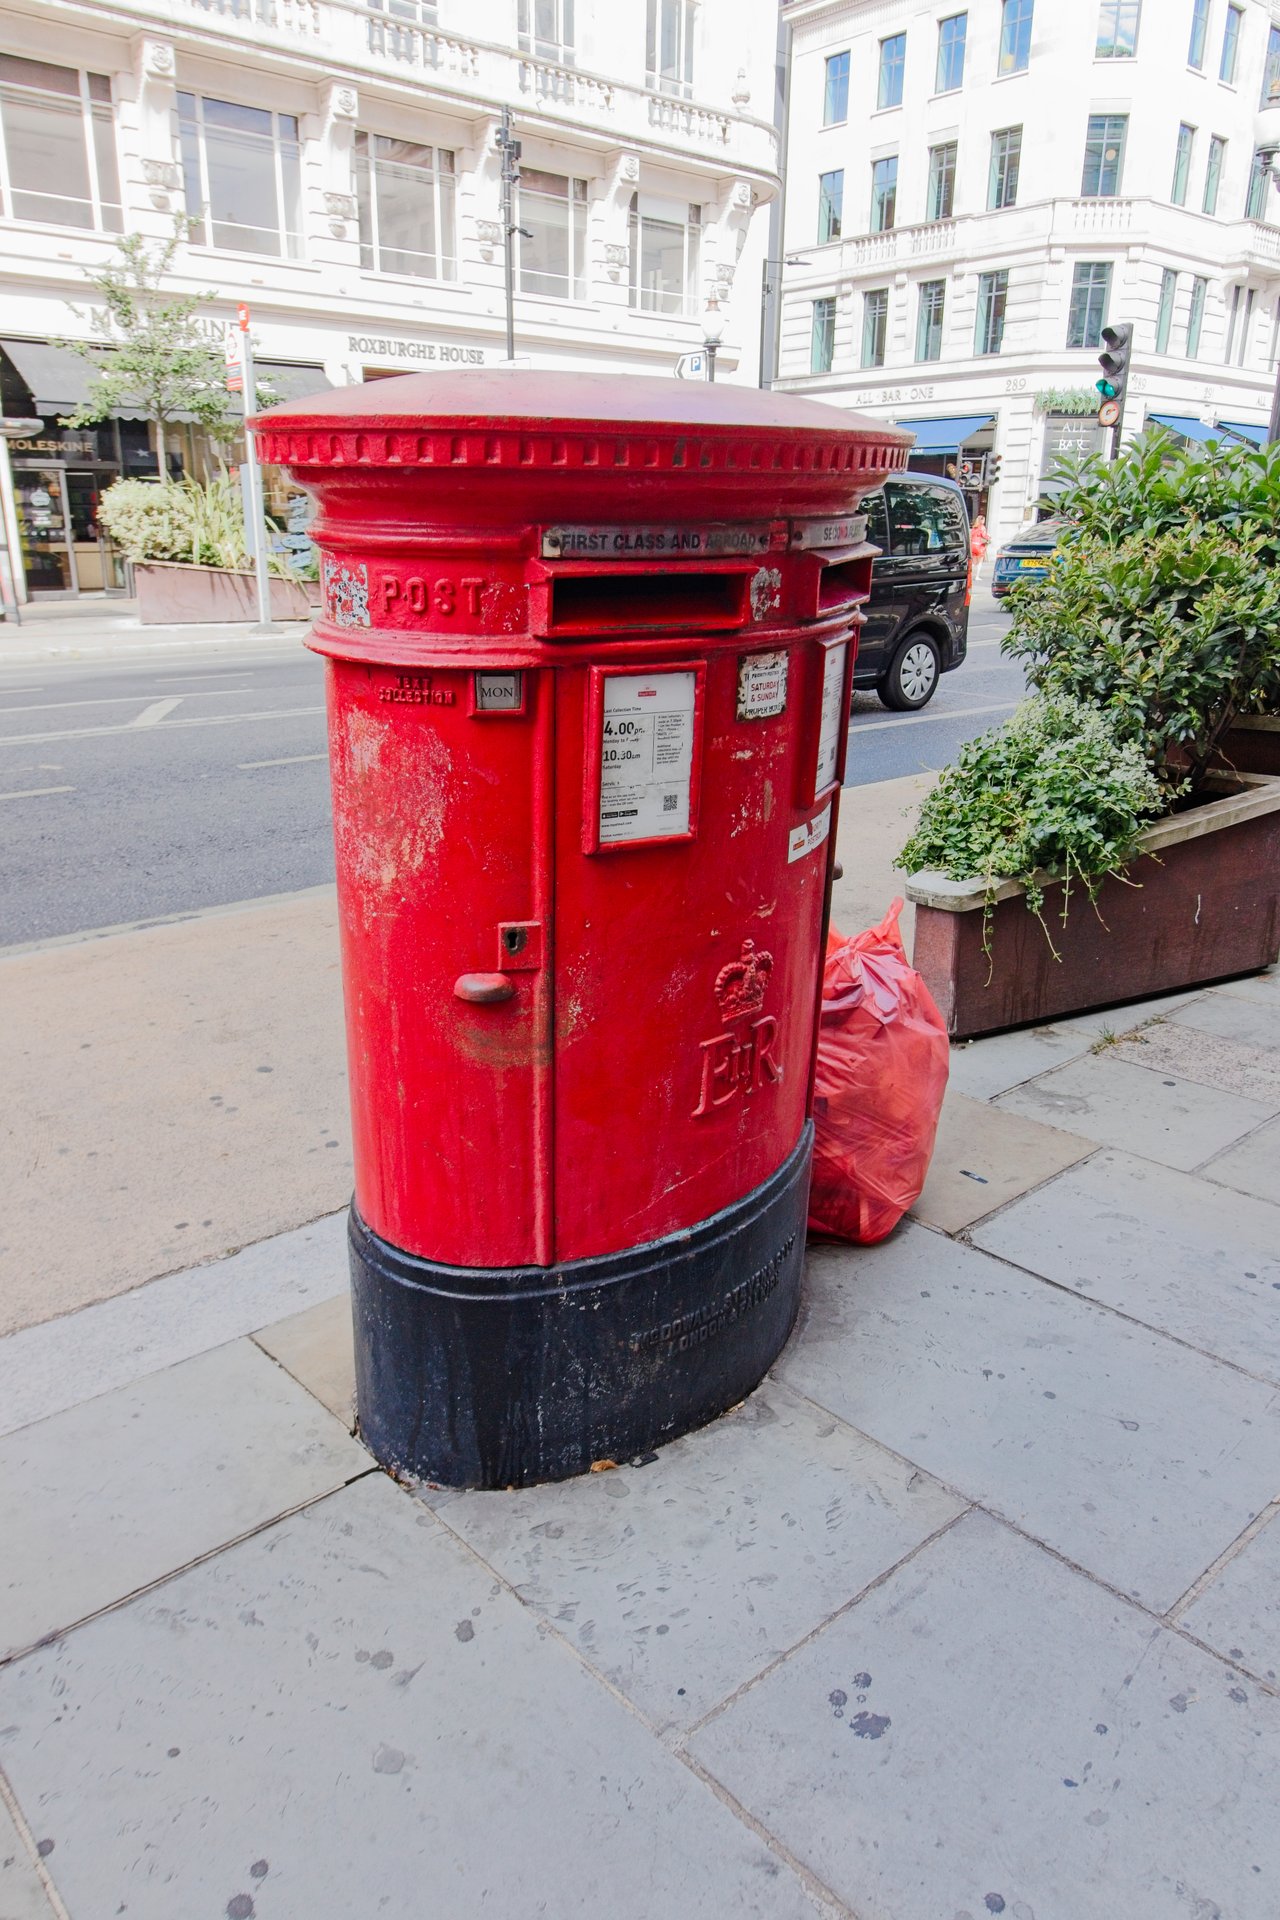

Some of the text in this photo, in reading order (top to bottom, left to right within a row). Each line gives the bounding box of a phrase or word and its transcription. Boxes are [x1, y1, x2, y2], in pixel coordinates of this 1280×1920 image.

[348, 336, 485, 364] ROXBURGHE HOUSE
[1005, 378, 1027, 392] 289
[882, 389, 901, 402] BAR
[911, 387, 934, 400] ONE
[1062, 422, 1087, 432] ALL
[1059, 439, 1089, 450] BAR
[560, 530, 756, 551] FIRST CLASS AND ABROAD
[381, 575, 486, 615] POST
[482, 687, 513, 698] MON
[751, 680, 779, 691] SATURDAY
[378, 686, 455, 705] COLLECTION
[757, 691, 778, 702] SUNDAY
